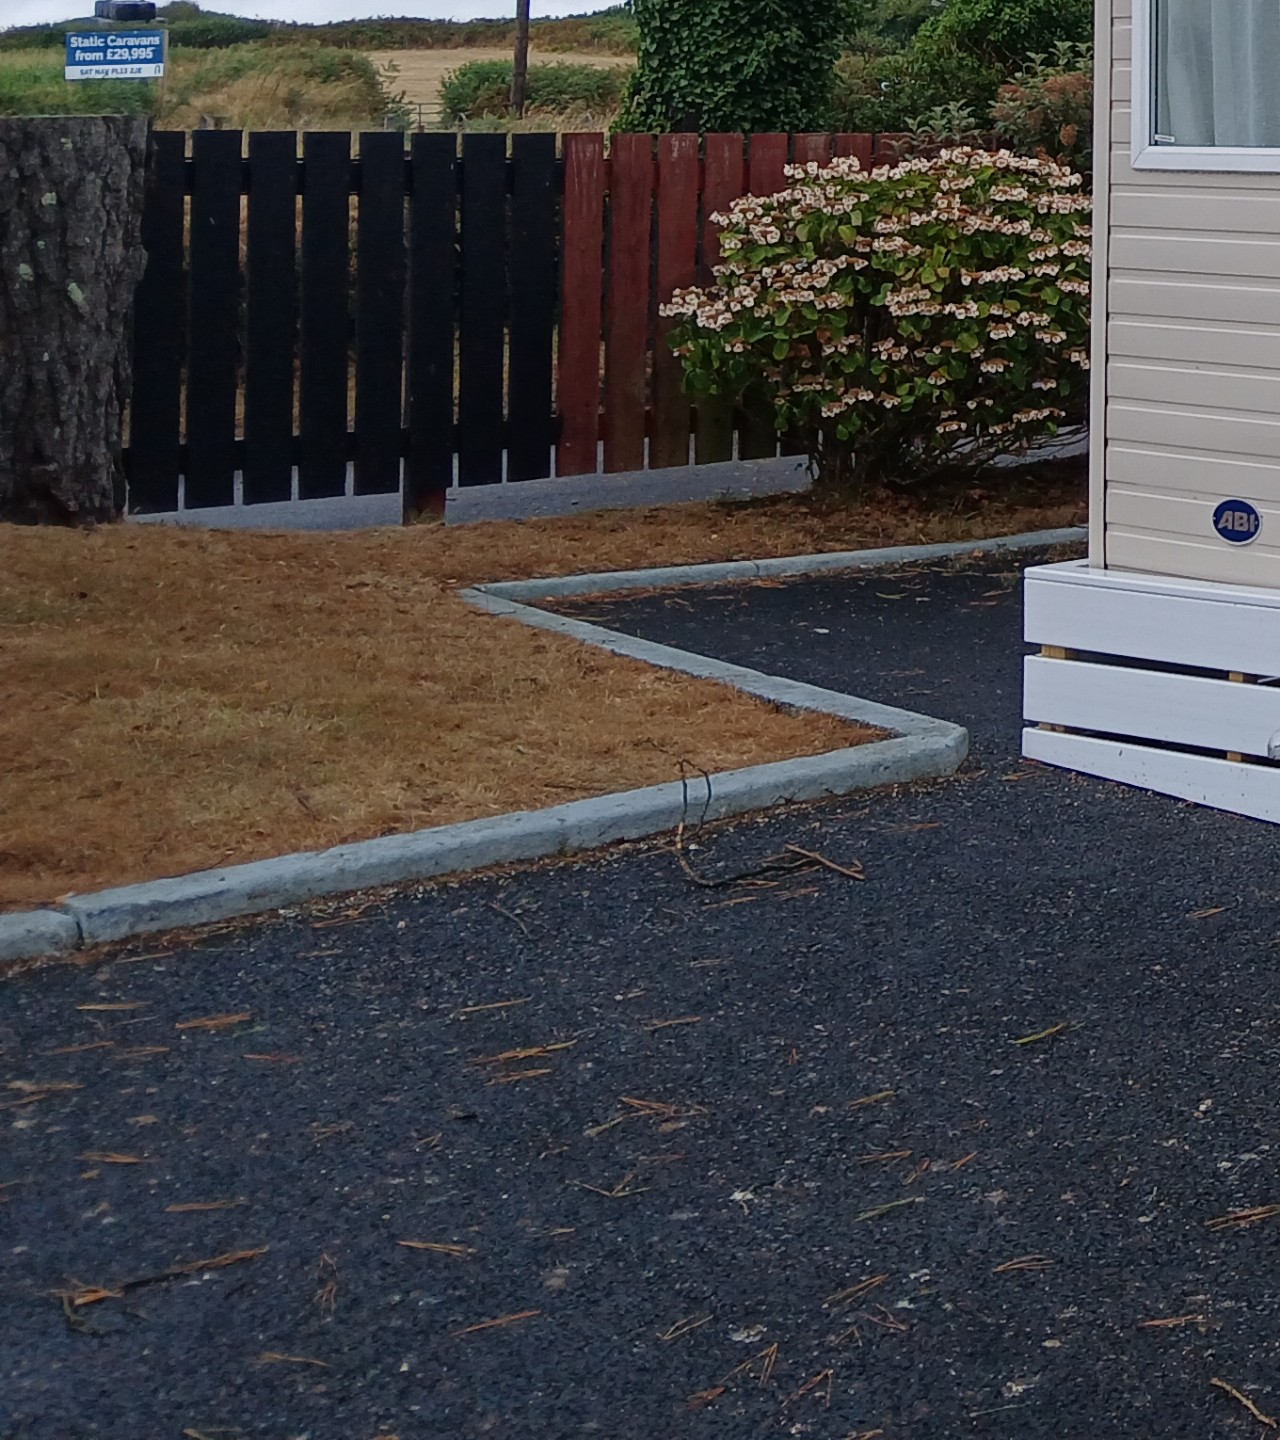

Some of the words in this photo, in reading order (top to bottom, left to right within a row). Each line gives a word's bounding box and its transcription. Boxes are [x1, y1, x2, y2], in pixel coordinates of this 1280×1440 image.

[70, 35, 105, 48] Static
[107, 35, 160, 47] Caravans
[75, 50, 104, 61] from
[106, 47, 155, 61] £29,995
[1217, 510, 1256, 533] ABI
